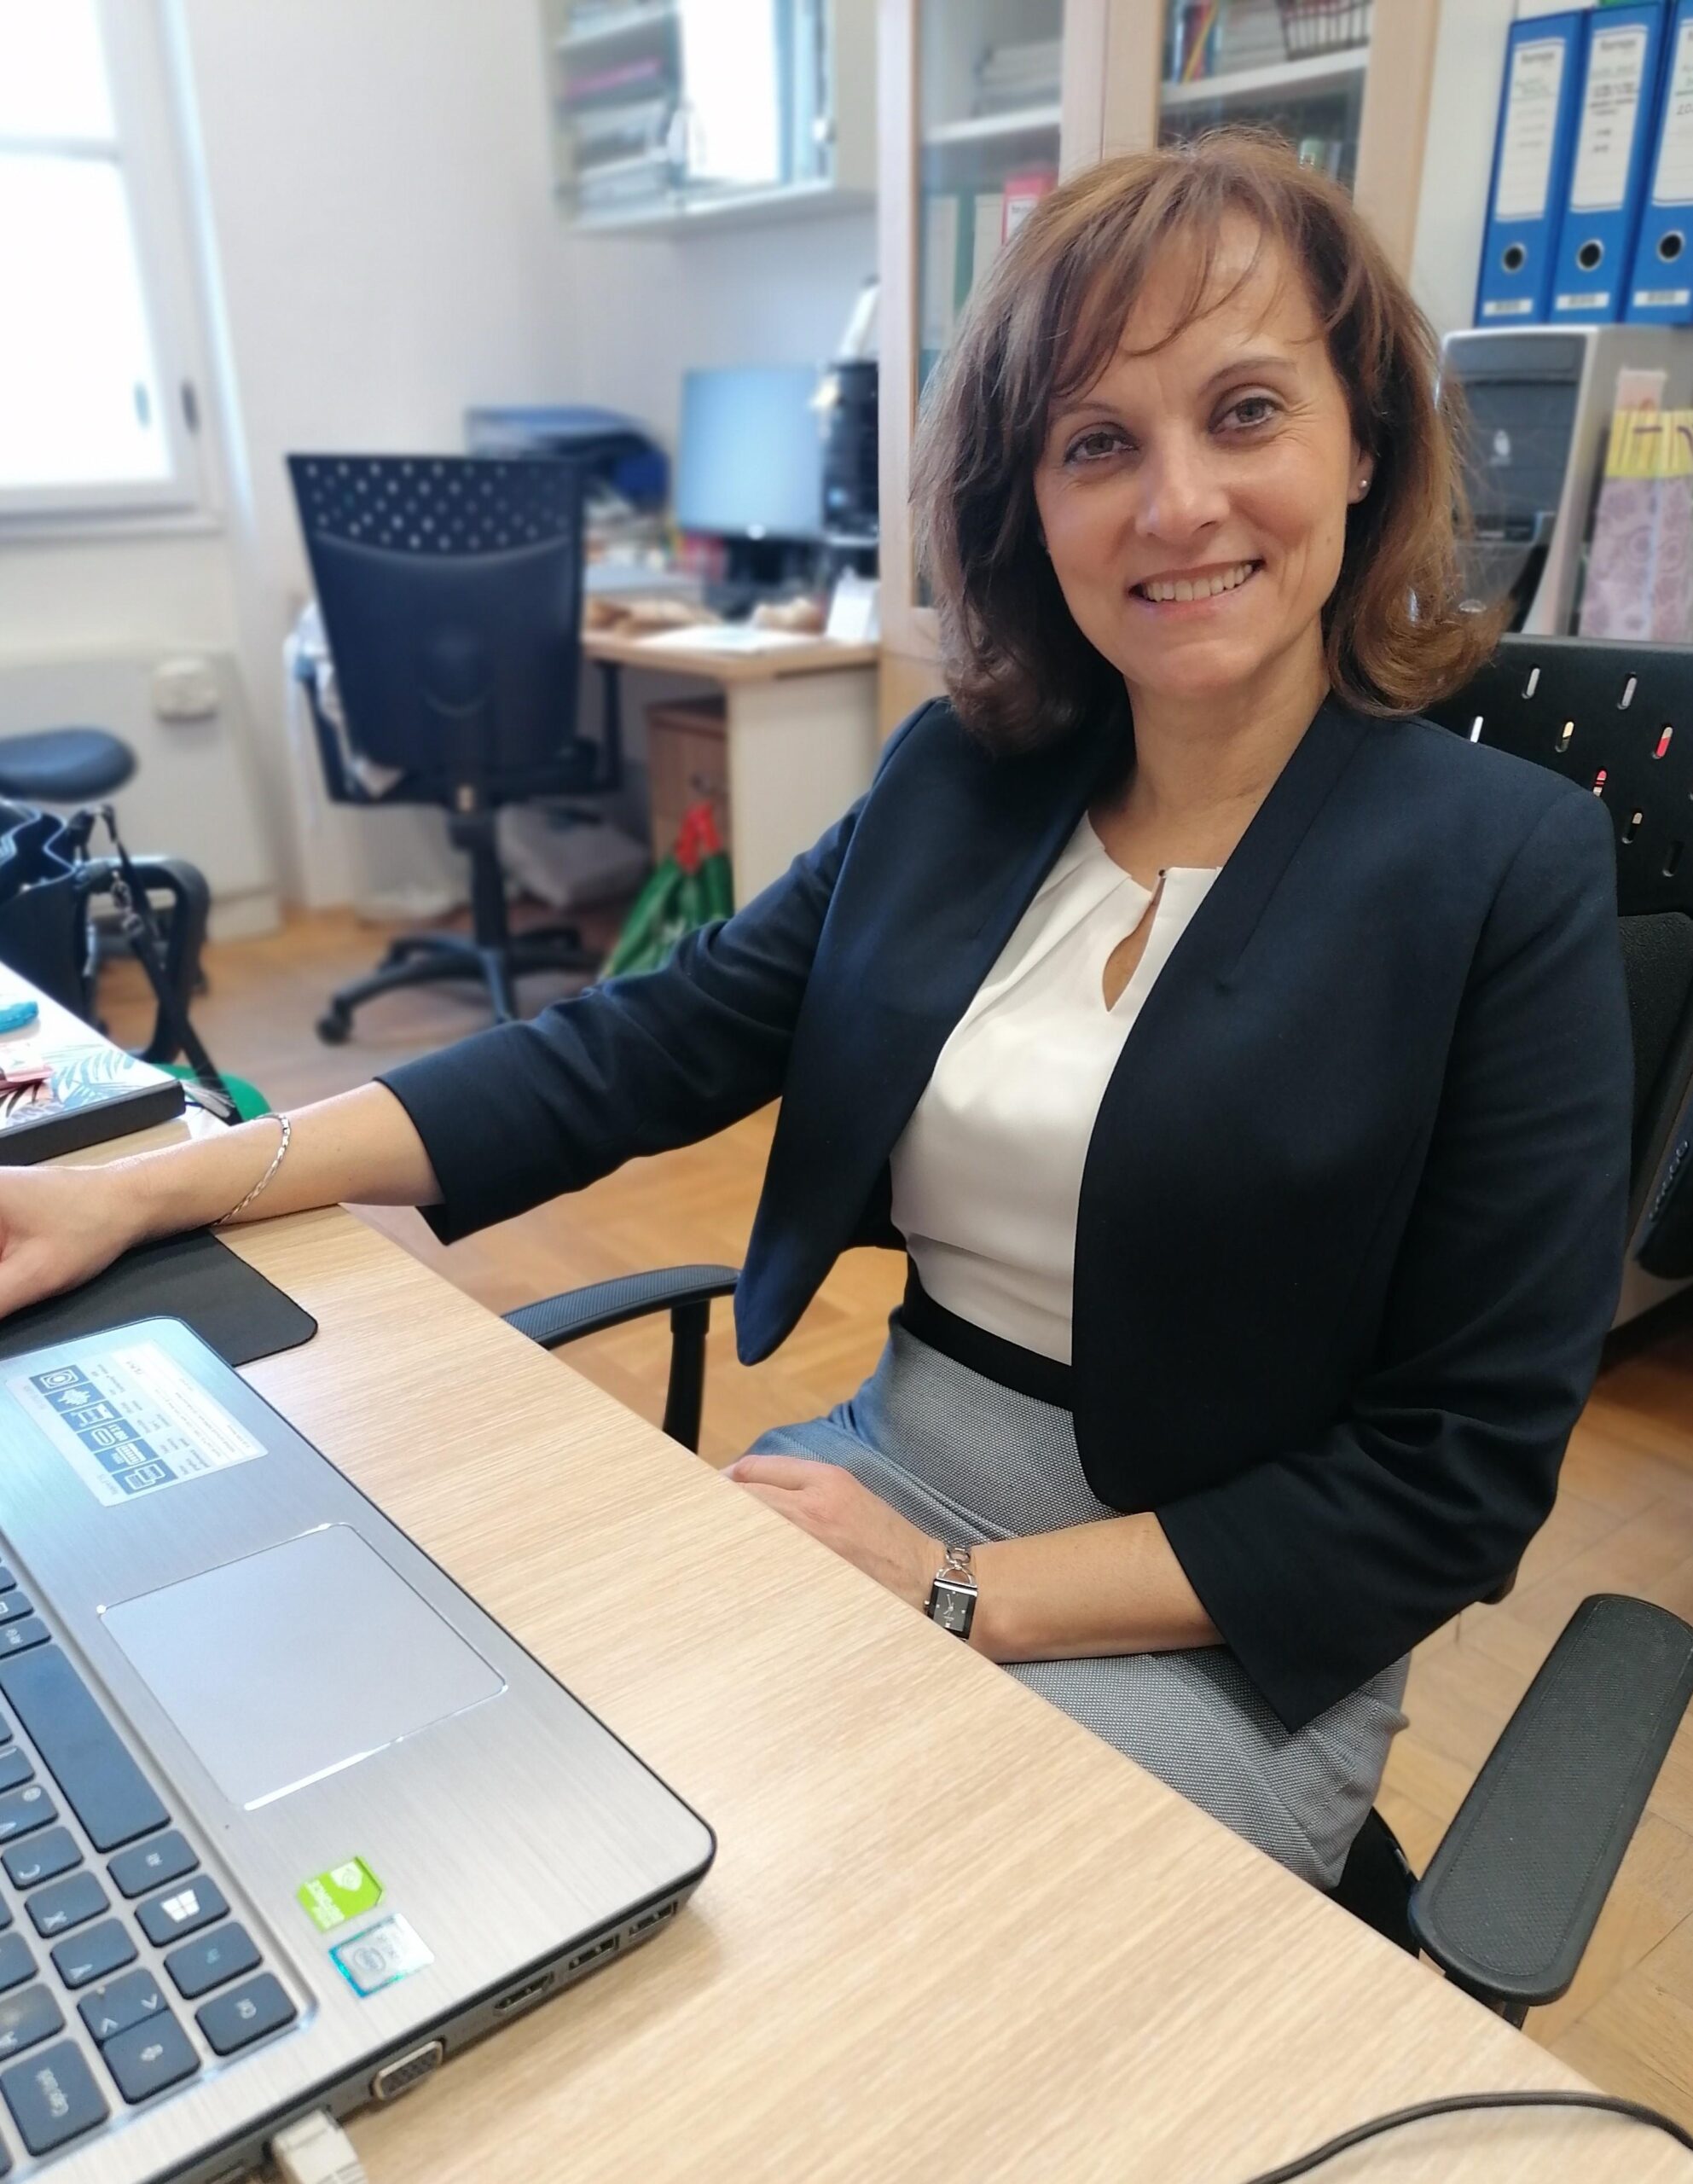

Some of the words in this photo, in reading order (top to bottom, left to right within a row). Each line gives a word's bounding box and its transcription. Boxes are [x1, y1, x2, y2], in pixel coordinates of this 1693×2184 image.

[18, 1864, 41, 1879] C
[45, 1910, 67, 1930] X
[70, 1964, 93, 1980] Y
[49, 2088, 69, 2117] Caps
